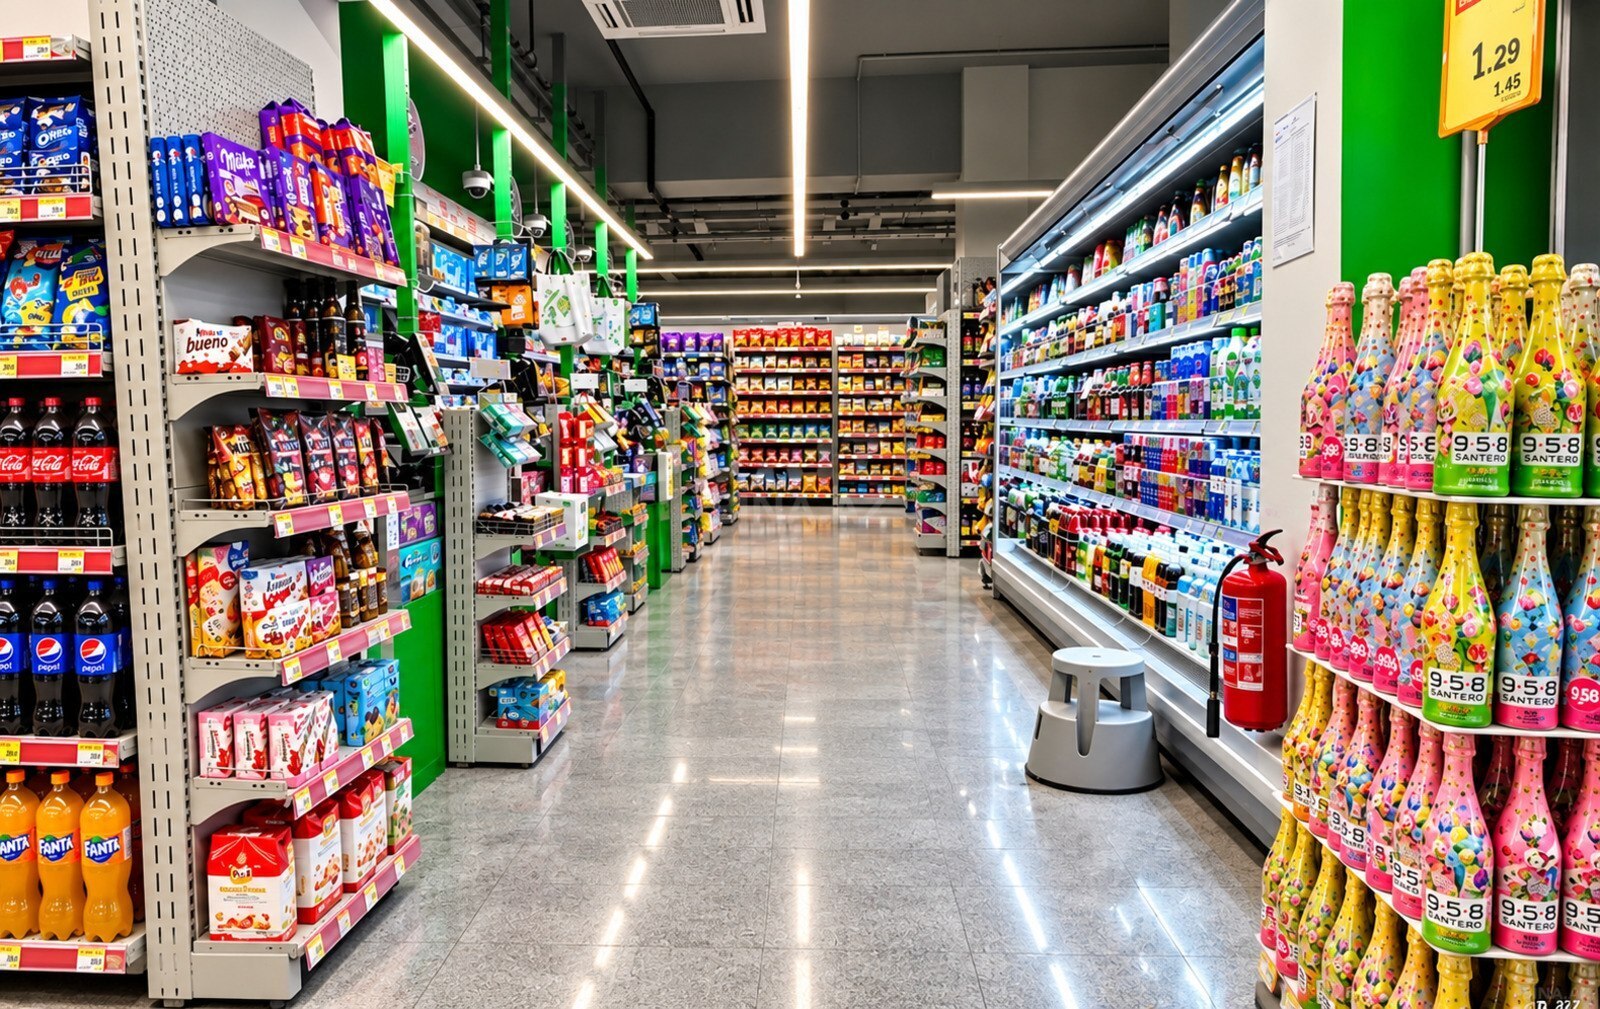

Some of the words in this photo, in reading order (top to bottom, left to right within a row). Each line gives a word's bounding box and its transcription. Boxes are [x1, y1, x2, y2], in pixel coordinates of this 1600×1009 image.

[1473, 37, 1520, 80] 1.29
[1494, 72, 1521, 97] 1.45
[186, 336, 228, 354] bueno
[1455, 453, 1506, 463] SANTERO
[1524, 454, 1579, 464] SANTERO
[1431, 688, 1484, 702] SANTERO
[1502, 693, 1555, 705] SANTERO
[0, 837, 30, 854] ANTA
[1502, 916, 1555, 931] SANTERO
[1565, 917, 1598, 933] SANT
